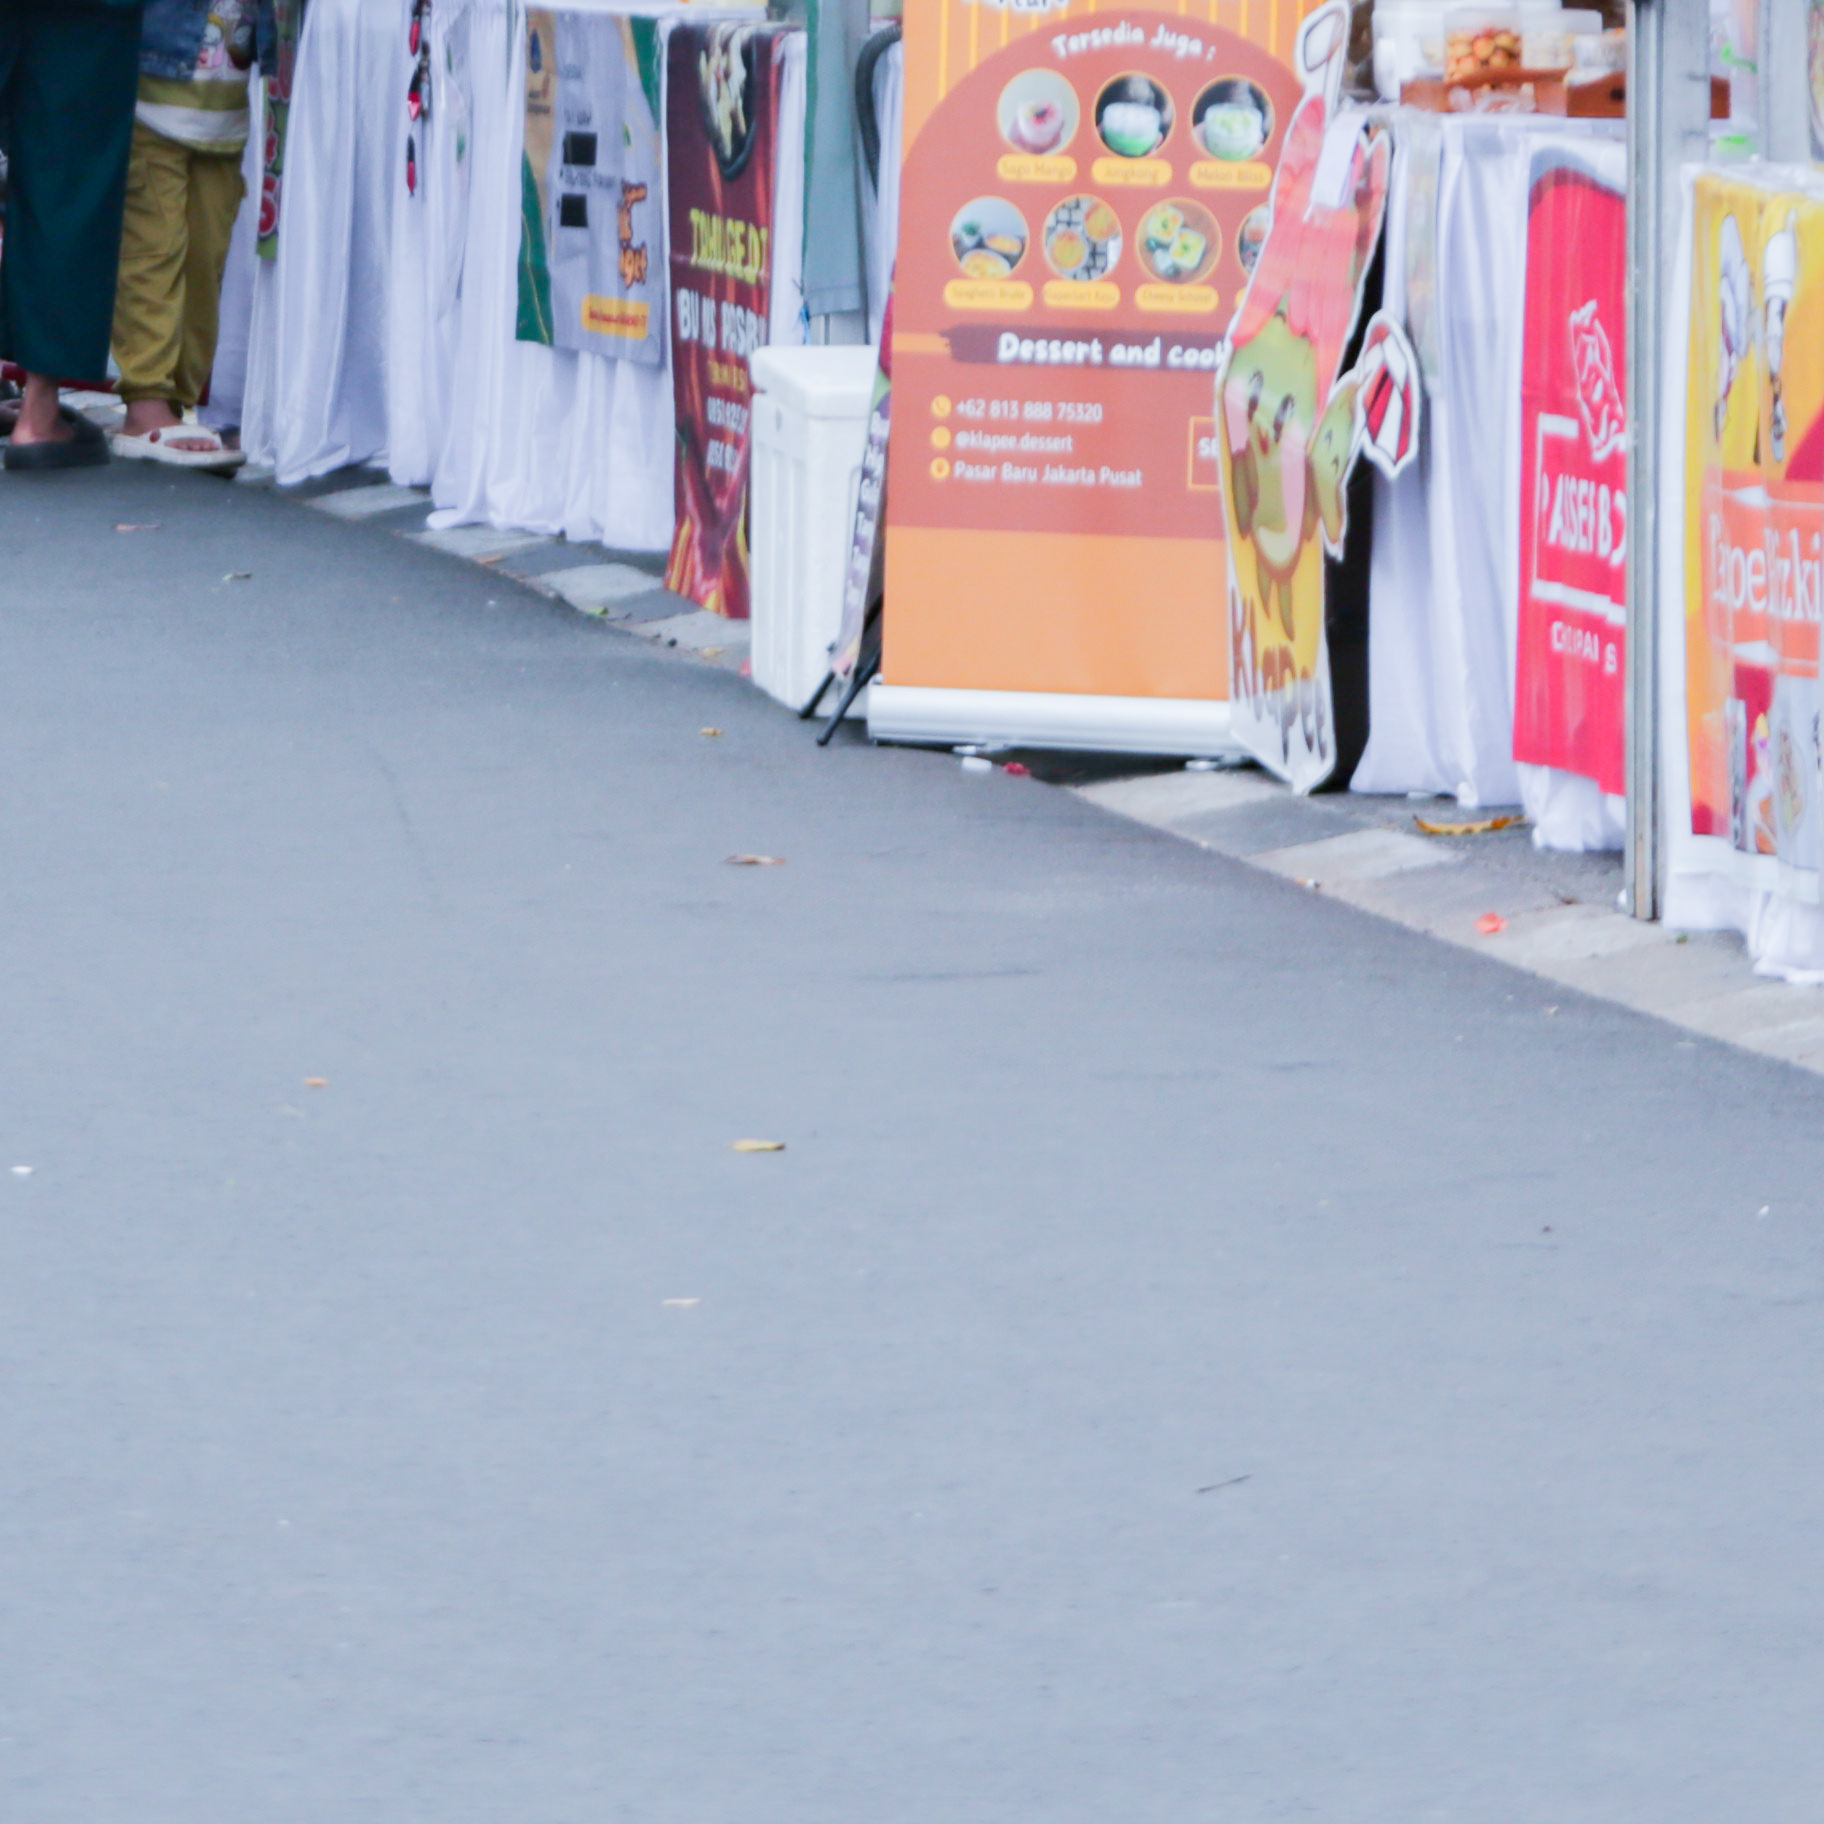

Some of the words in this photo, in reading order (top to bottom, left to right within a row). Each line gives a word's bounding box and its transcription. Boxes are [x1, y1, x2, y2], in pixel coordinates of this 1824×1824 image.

[1053, 21, 1144, 57] Tersedia
[1152, 24, 1202, 57] Juga
[997, 331, 1103, 366] Dessert
[1109, 336, 1161, 366] and
[956, 399, 986, 418] +62
[990, 399, 1019, 418] 813
[955, 430, 1073, 452] @klapee.dessert
[954, 460, 997, 479] Pasar
[1002, 462, 1037, 481] Baru
[1043, 464, 1095, 484] Jakarta
[1100, 466, 1143, 486] Pusat
[1231, 584, 1327, 765] Klapee
